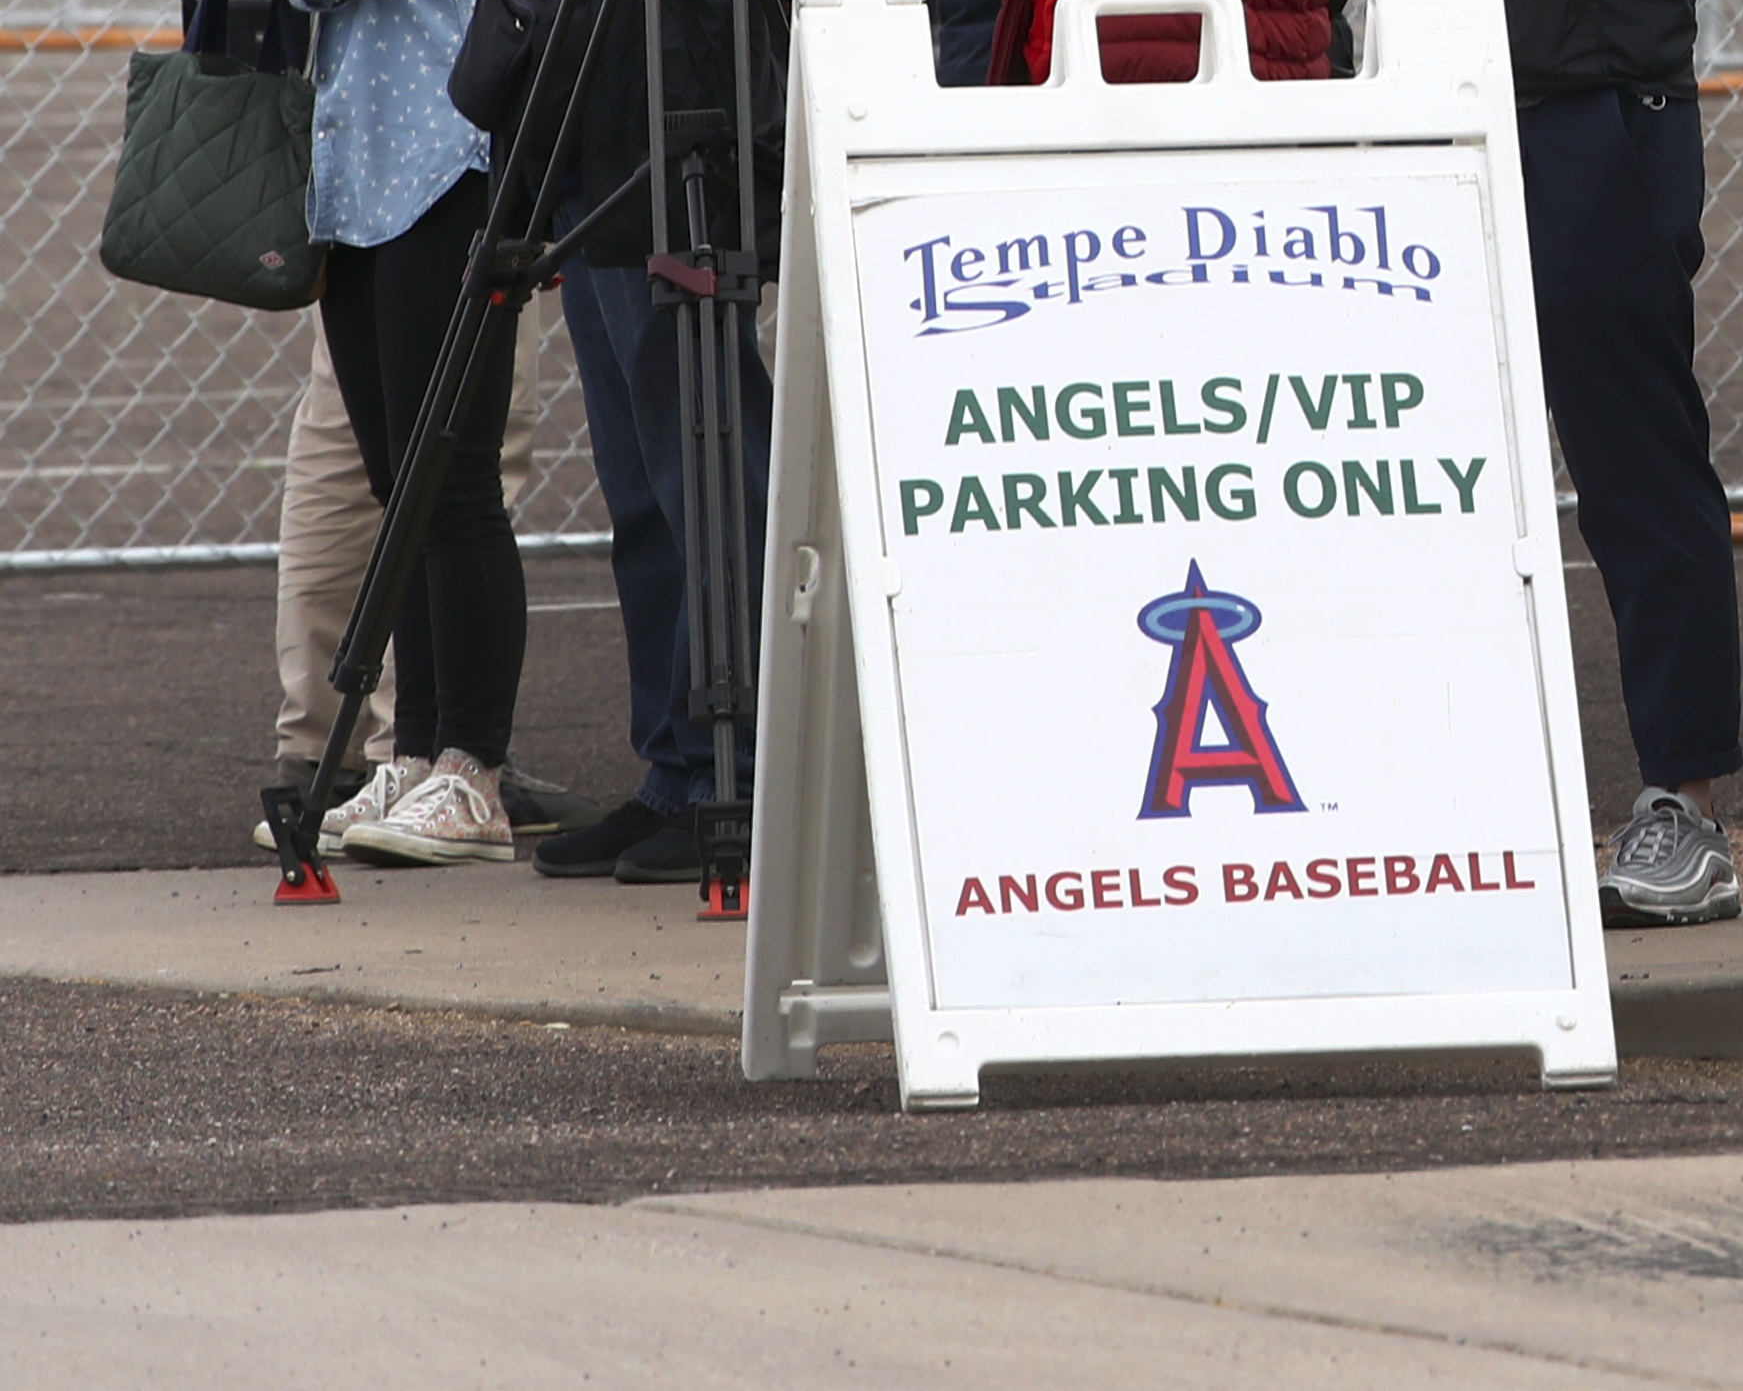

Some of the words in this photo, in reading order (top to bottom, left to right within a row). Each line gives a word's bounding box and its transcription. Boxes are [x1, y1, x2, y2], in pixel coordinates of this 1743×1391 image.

[904, 224, 1147, 323] Tempe
[1181, 205, 1442, 280] Diablo
[909, 263, 1433, 337] Stadium
[944, 373, 1425, 446] ANGELS/VIP
[898, 462, 1258, 536] PARKING
[1283, 457, 1487, 519] ONLY
[1136, 557, 1310, 820] A
[954, 865, 1200, 917] ANGELS
[1222, 850, 1536, 903] BASEBALL
